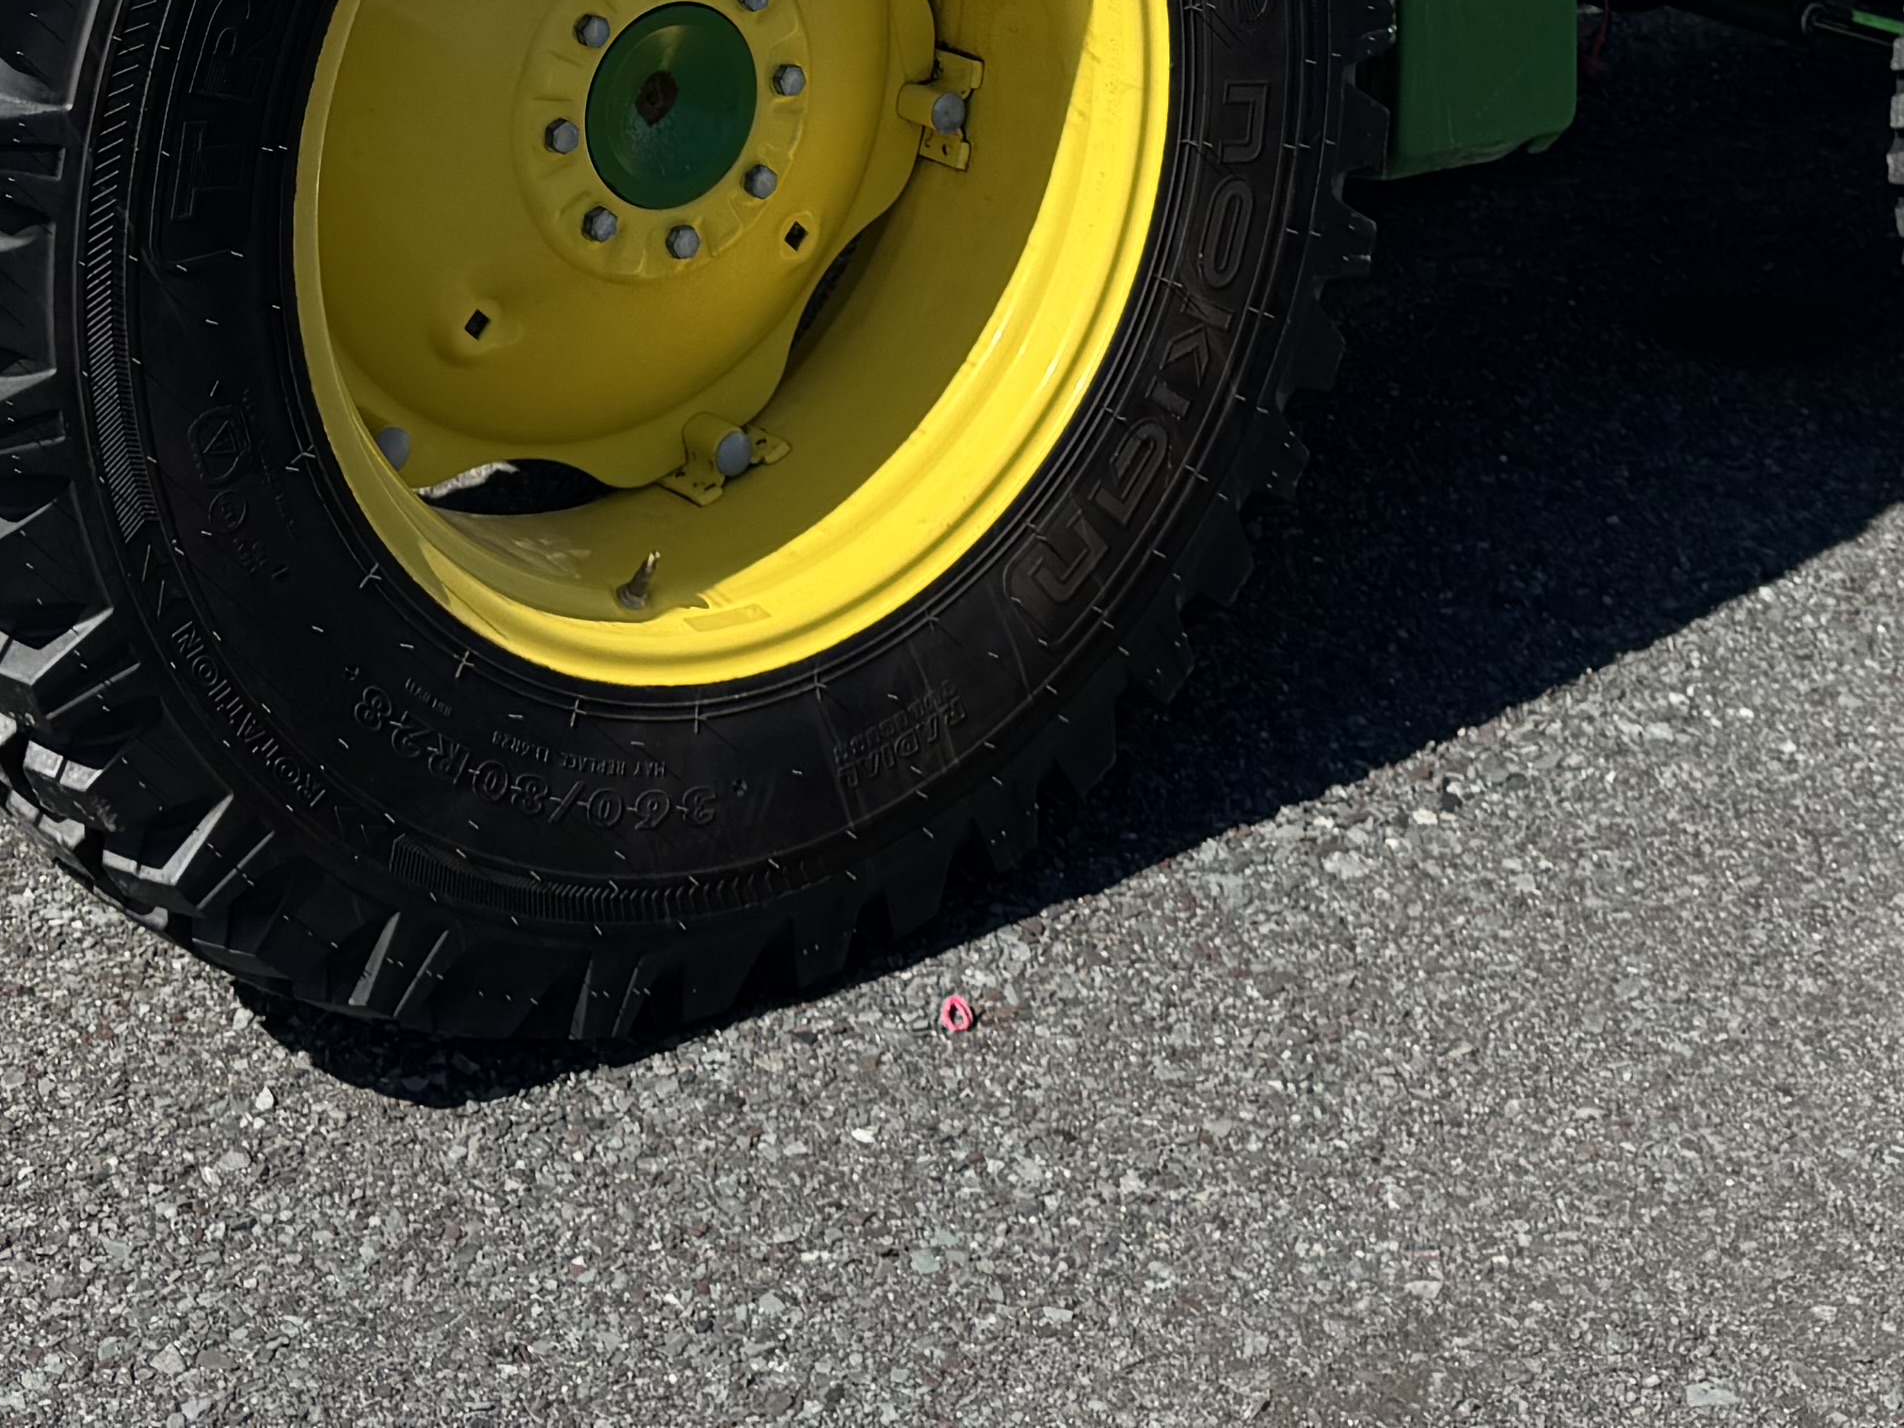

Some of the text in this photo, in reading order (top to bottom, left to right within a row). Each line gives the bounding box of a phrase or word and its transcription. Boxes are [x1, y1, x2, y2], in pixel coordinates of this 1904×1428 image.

[1031, 79, 1271, 606] nokian
[170, 620, 327, 808] ROTATION
[353, 683, 717, 831] 360/80R28
[836, 695, 968, 790] RADIAL
